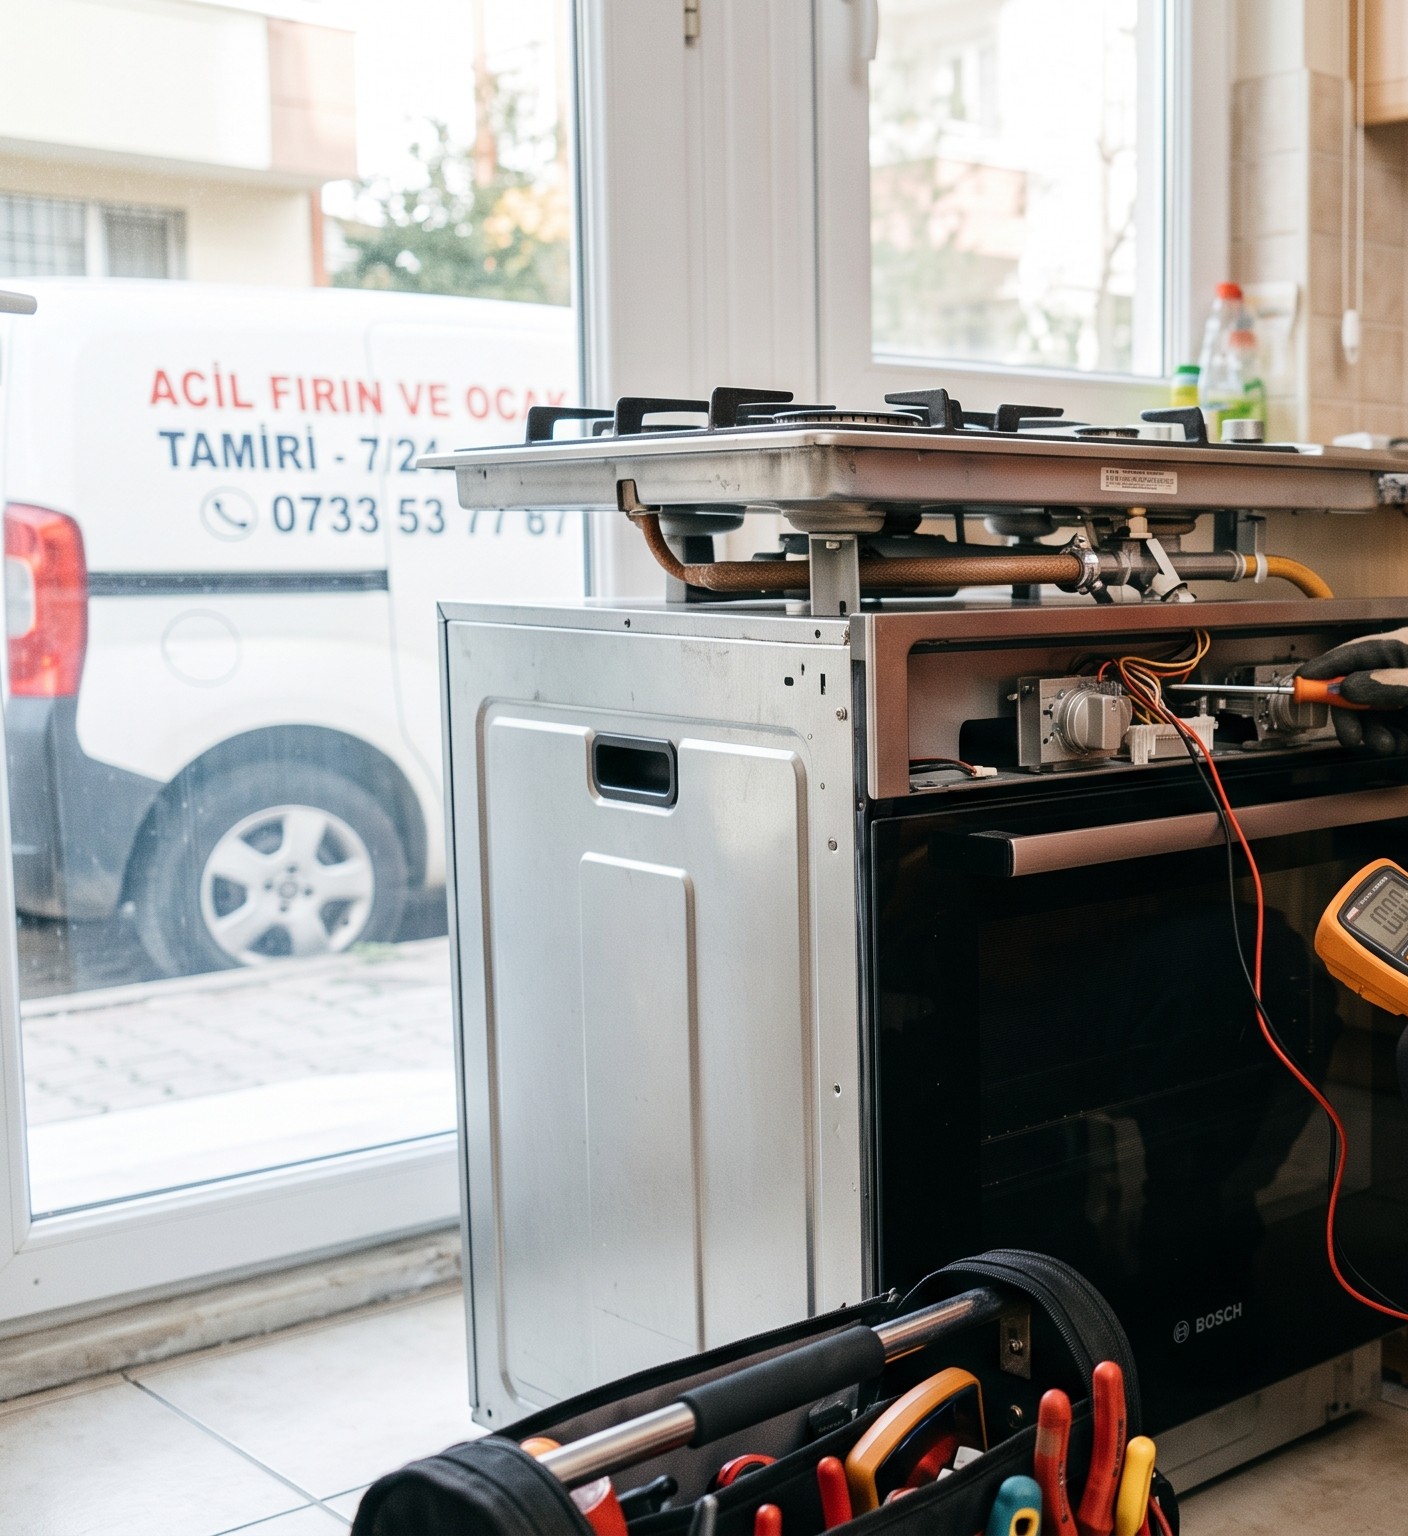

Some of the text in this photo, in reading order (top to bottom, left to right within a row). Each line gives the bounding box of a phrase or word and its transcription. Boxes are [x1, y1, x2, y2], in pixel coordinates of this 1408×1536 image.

[149, 361, 254, 409] ACİL
[269, 376, 383, 415] FIRIN
[398, 382, 450, 418] VE
[158, 424, 317, 470] TAMİRİ
[272, 495, 379, 533] 0733
[399, 498, 445, 534] 53
[1195, 1302, 1242, 1333] BOSCH
